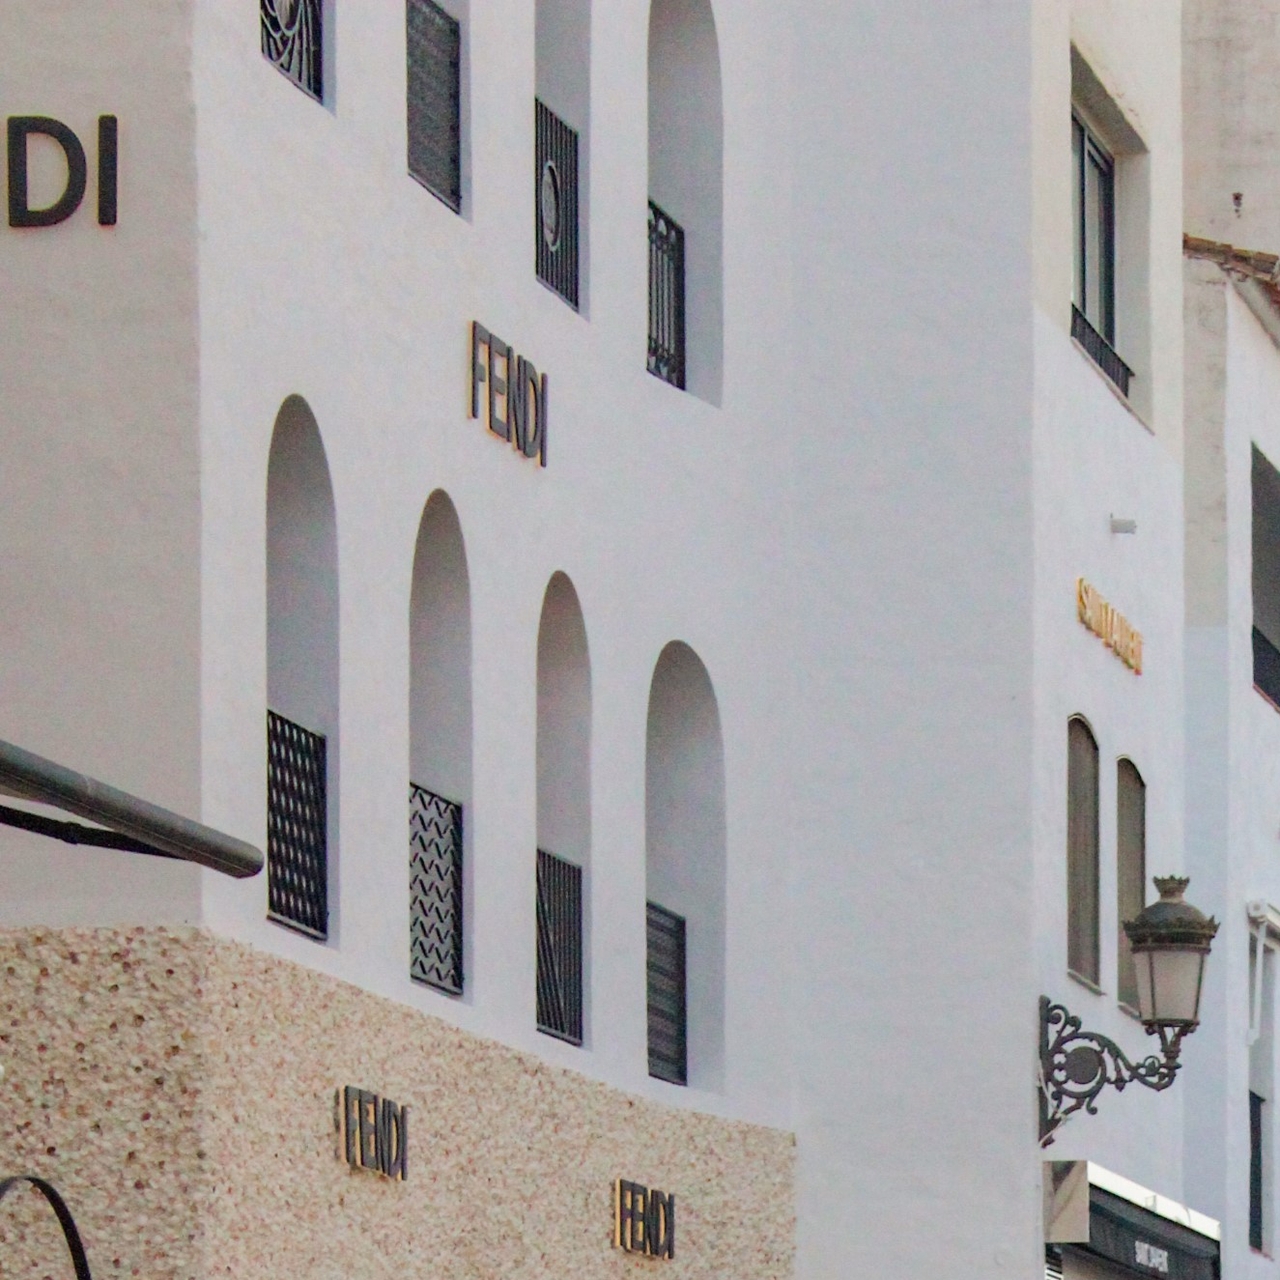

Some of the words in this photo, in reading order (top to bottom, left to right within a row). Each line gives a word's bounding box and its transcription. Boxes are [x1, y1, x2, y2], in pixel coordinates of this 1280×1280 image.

[7, 114, 118, 228] DI
[468, 320, 548, 468] FENDI
[341, 1086, 409, 1181] FENDI
[614, 1178, 675, 1260] FENDI
